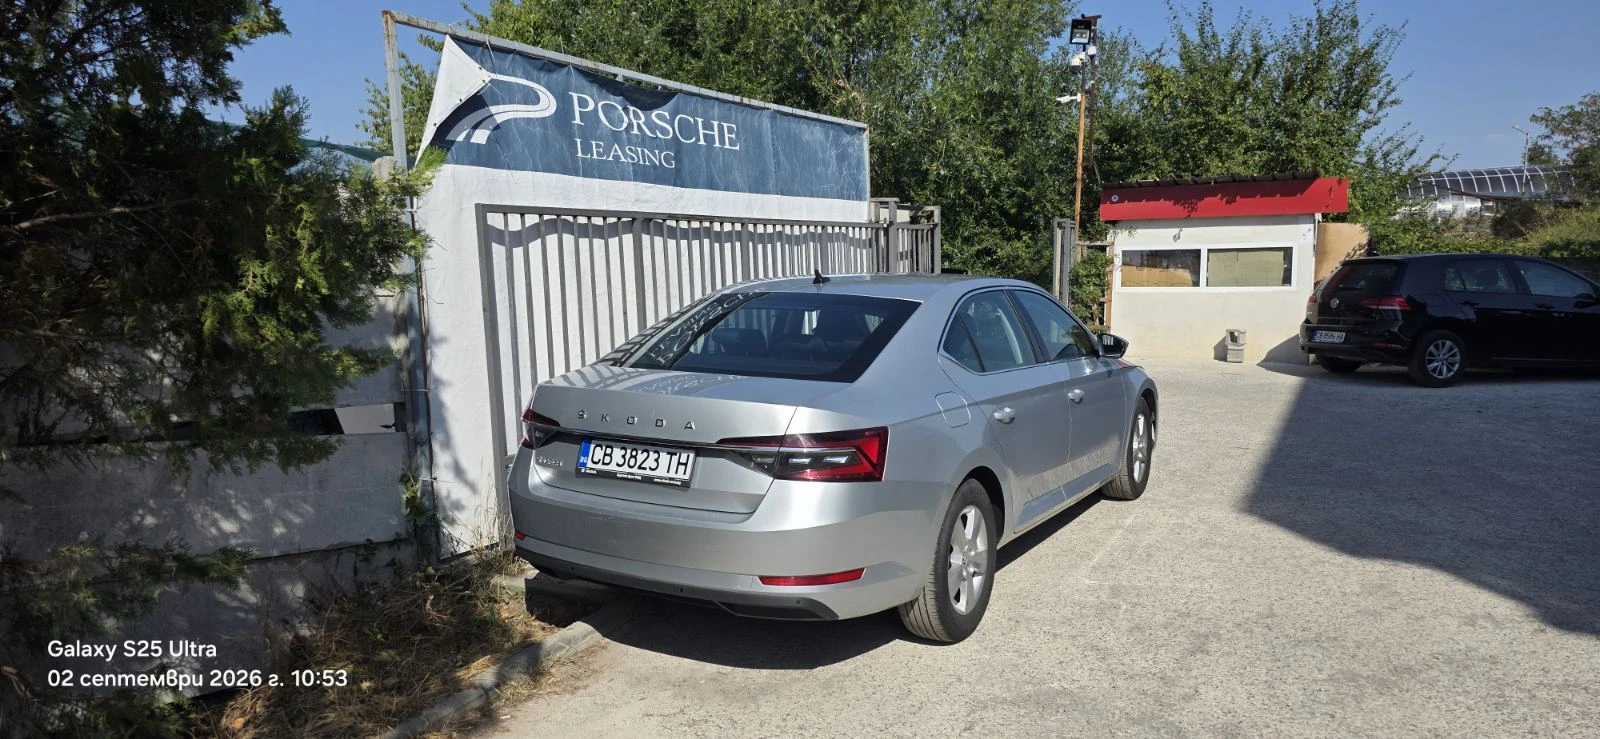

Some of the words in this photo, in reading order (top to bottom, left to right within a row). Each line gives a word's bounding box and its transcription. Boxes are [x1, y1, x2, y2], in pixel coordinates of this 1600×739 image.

[568, 91, 740, 150] PORSCHE
[574, 138, 676, 169] LEASING
[577, 409, 695, 430] ŠKODA
[590, 443, 614, 466] CB
[615, 446, 661, 472] 3823
[665, 451, 690, 476] TH
